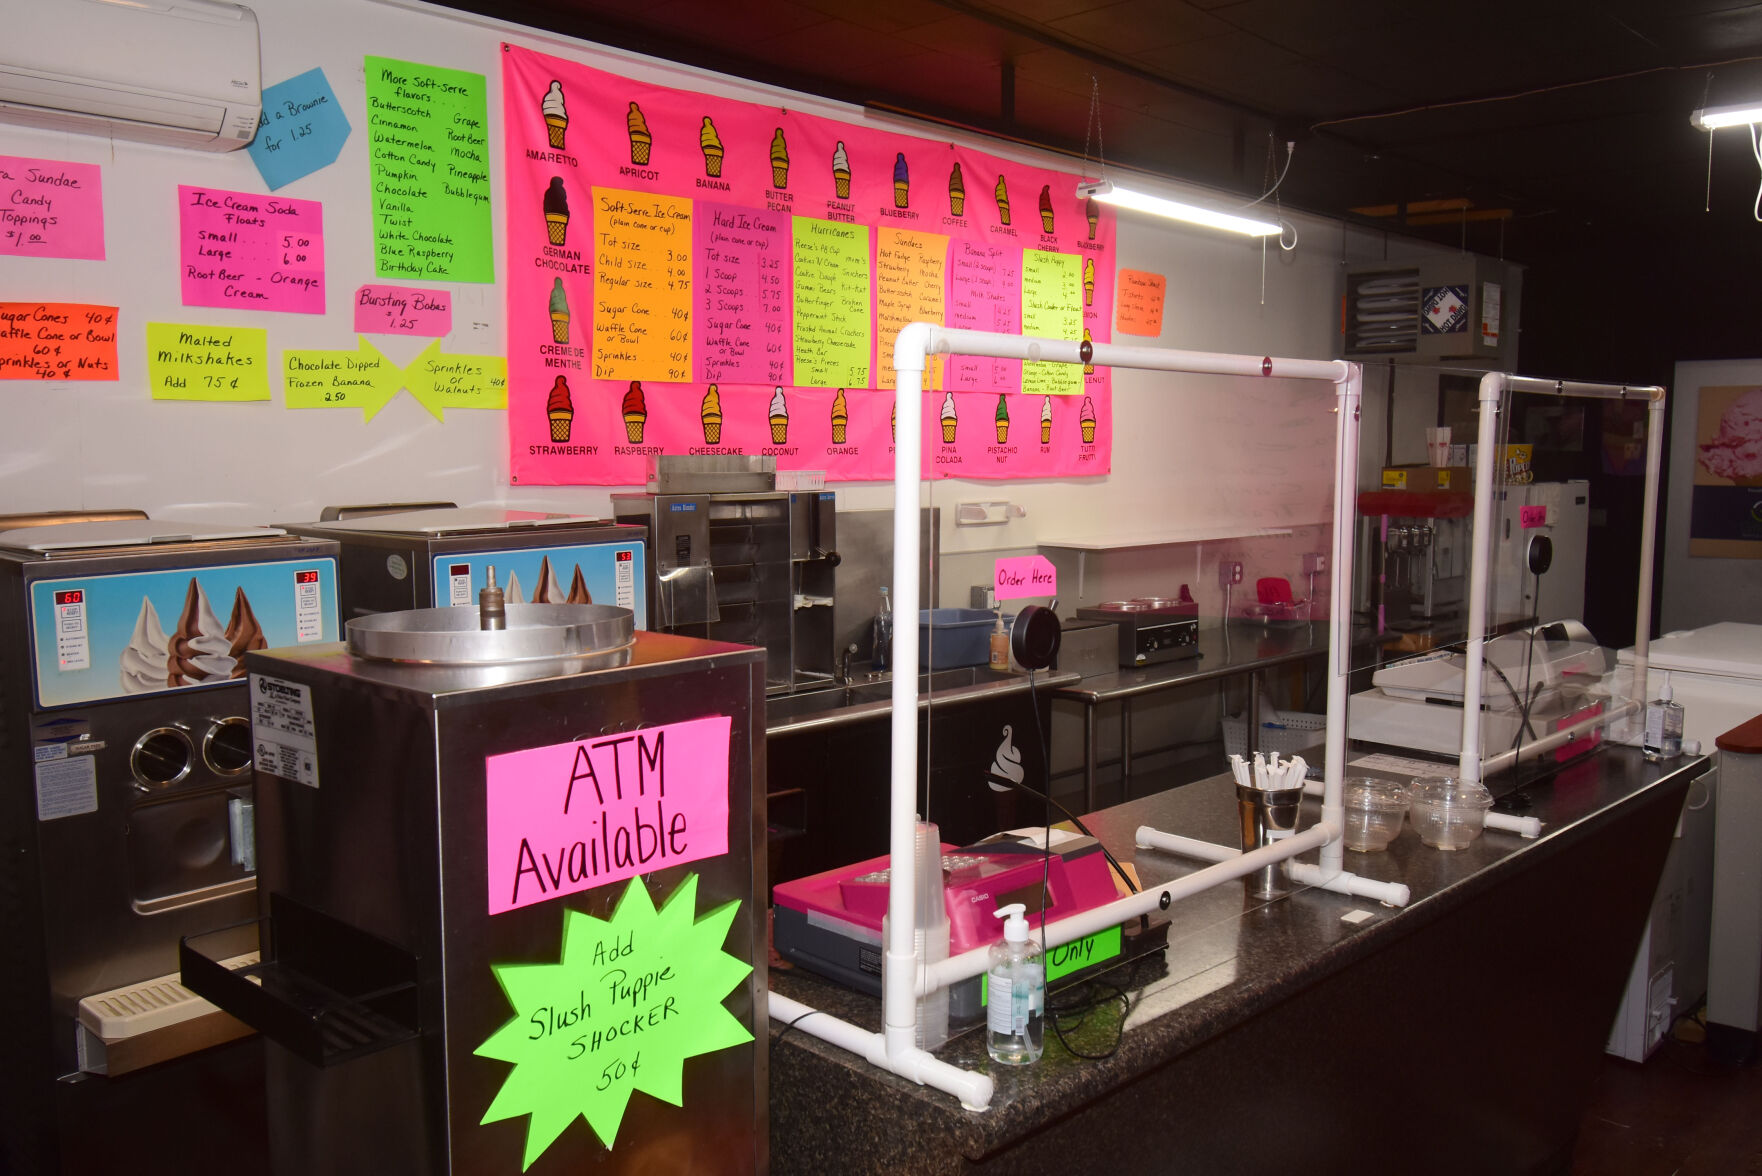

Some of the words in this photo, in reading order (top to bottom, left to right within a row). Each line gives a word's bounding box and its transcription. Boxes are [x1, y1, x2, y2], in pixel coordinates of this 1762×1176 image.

[381, 69, 407, 85] More
[412, 77, 469, 97] Soft-Serve
[394, 87, 431, 102] flavors
[283, 96, 328, 116] Brownie
[370, 97, 431, 118] Butterscotch
[371, 114, 417, 132] Cinnamon
[453, 113, 480, 129] Grape
[265, 136, 282, 153] for
[374, 130, 435, 152] Watermelon
[374, 148, 405, 162] Cotton
[409, 154, 436, 173] Candy
[451, 147, 482, 163] Mocha
[526, 149, 578, 168] AMARETTO
[26, 168, 81, 189] Sundae
[374, 164, 418, 181] Pumpkin
[447, 164, 488, 183] Pineapple
[619, 166, 660, 181] APRICOT
[376, 182, 428, 198] Chocolate
[696, 178, 731, 192] BANANA
[11, 189, 52, 212] Candy
[442, 182, 489, 206] Bubblegum
[765, 189, 794, 201] BUTTER
[190, 192, 222, 209] Ice
[224, 196, 259, 212] Cream
[265, 201, 299, 216] Soda
[379, 198, 413, 213] Vanilla
[601, 197, 650, 217] Soft-Serve
[653, 204, 666, 218] Ice
[667, 205, 690, 221] Cream
[766, 201, 792, 213] PECAN
[826, 200, 855, 212] PEANUT
[0, 209, 58, 230] Toppings
[223, 213, 266, 227] Floats
[379, 213, 413, 226] Twist
[713, 210, 734, 228] Hard
[737, 214, 751, 230] Ice
[753, 217, 777, 232] Cream
[827, 211, 855, 223] BUTTER
[880, 207, 919, 220] BLUEBERRY
[610, 215, 629, 228] (plain
[633, 221, 647, 229] cone
[660, 223, 675, 235] cup)
[942, 216, 968, 228] COFFEE
[379, 229, 409, 240] White
[412, 230, 453, 245] Chocolate
[811, 223, 855, 239] Hurricanes
[990, 225, 1018, 238] CARAMEL
[600, 233, 617, 248] Tot
[621, 241, 640, 250] size
[1040, 234, 1058, 246] BLACK
[198, 245, 232, 261] Large
[380, 243, 404, 256] Blue
[407, 245, 453, 263] Raspberry
[543, 245, 581, 261] GERMAN
[705, 248, 720, 261] Tot
[723, 255, 740, 264] size
[879, 248, 892, 258] Hot
[894, 250, 911, 264] Fudge
[1037, 244, 1059, 254] CHERRY
[379, 259, 422, 277] Birthday
[426, 261, 449, 274] Cake
[534, 258, 591, 275] CHOCOLATE
[599, 253, 622, 268] Child
[628, 260, 647, 270] size
[187, 265, 216, 280] Root
[218, 269, 245, 281] Beer
[270, 271, 319, 291] Orange
[599, 272, 630, 290] Regular
[714, 269, 737, 282] Scoop
[224, 285, 269, 300] Cream
[705, 284, 711, 294] 2
[717, 285, 744, 298] Scoops
[360, 288, 407, 316] Bursting
[599, 301, 628, 319] Sugar
[632, 303, 650, 315] Cone
[706, 298, 711, 310] 3
[717, 300, 744, 314] Scoops
[33, 306, 69, 324] Cones
[596, 322, 625, 332] Waffle
[629, 323, 647, 335] Cone
[707, 317, 733, 335] Sugar
[735, 319, 751, 330] Cone
[37, 326, 65, 341] Cone
[69, 333, 82, 341] or
[86, 329, 115, 343] Bowl
[179, 331, 232, 346] Malted
[618, 333, 639, 344] Bowl
[706, 336, 732, 347] Waffle
[735, 337, 750, 347] Cone
[157, 350, 253, 366] Milkshakes
[539, 344, 573, 357] CREME
[574, 347, 585, 358] DE
[597, 348, 637, 363] Sprinkles
[729, 347, 745, 356] Bowl
[57, 361, 71, 370] or
[77, 357, 109, 370] Nuts
[289, 356, 342, 371] Chocolate
[346, 357, 380, 372] Dipped
[424, 359, 482, 376] Sprinkles
[545, 358, 582, 370] MENTHE
[596, 364, 614, 377] Dip
[705, 357, 740, 368] Sprinkles
[164, 375, 186, 388] Add
[288, 376, 324, 388] Frozen
[332, 376, 375, 388] Banana
[450, 376, 463, 384] or
[706, 368, 722, 380] Dip
[433, 382, 482, 394] Walnuts
[529, 445, 599, 456] STRAWBERRY
[614, 446, 664, 456] RASPBERRY
[689, 447, 743, 456] CHEESECAKE
[762, 447, 799, 456] COCONUT
[826, 447, 859, 455] ORANGE
[941, 446, 957, 454] PINA
[987, 446, 1018, 454] PISTACHIO
[935, 456, 963, 464] COLADA
[996, 456, 1007, 464] NUT
[620, 553, 631, 561] 53
[303, 572, 317, 583] 39
[998, 568, 1026, 586] Order
[1031, 568, 1052, 584] Here
[64, 592, 80, 604] 60
[564, 731, 665, 815] ATM
[512, 801, 688, 905] Available
[971, 893, 989, 903] CASIO
[592, 930, 634, 966] Add
[1053, 938, 1095, 966] Only
[528, 990, 592, 1041] Slush
[599, 965, 676, 1008] Puppie
[567, 996, 680, 1060] SHOCKER
[596, 1051, 641, 1092] 50¢
